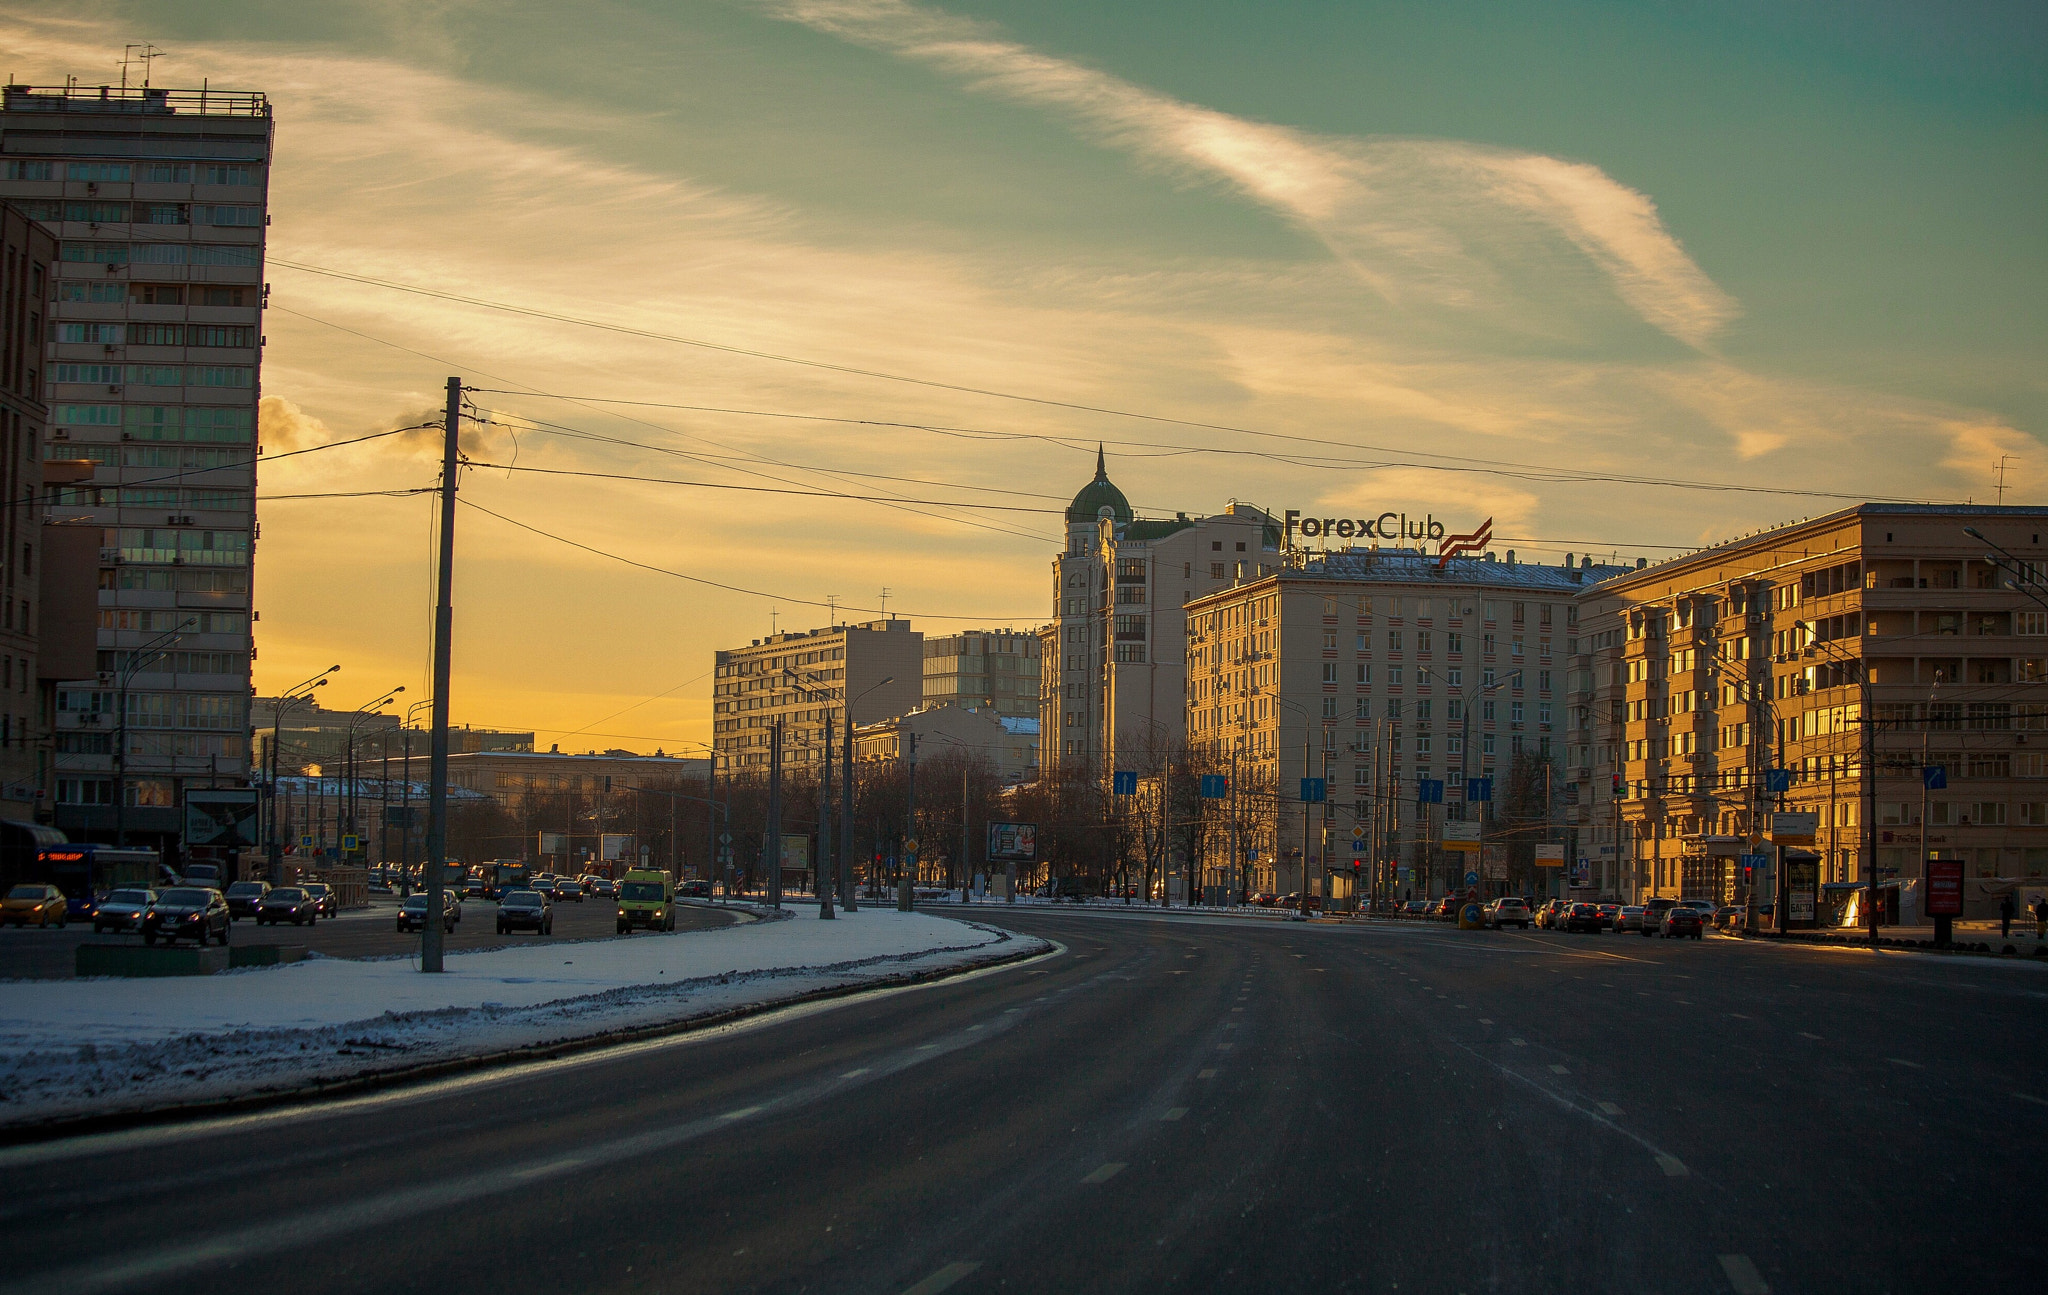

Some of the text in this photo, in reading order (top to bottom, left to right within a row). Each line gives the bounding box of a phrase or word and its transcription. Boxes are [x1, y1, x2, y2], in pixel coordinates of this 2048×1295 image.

[1283, 510, 1445, 540] ForexClub
[1896, 834, 1948, 843] РосЕвБанк
[1790, 903, 1813, 913] БАСТА
